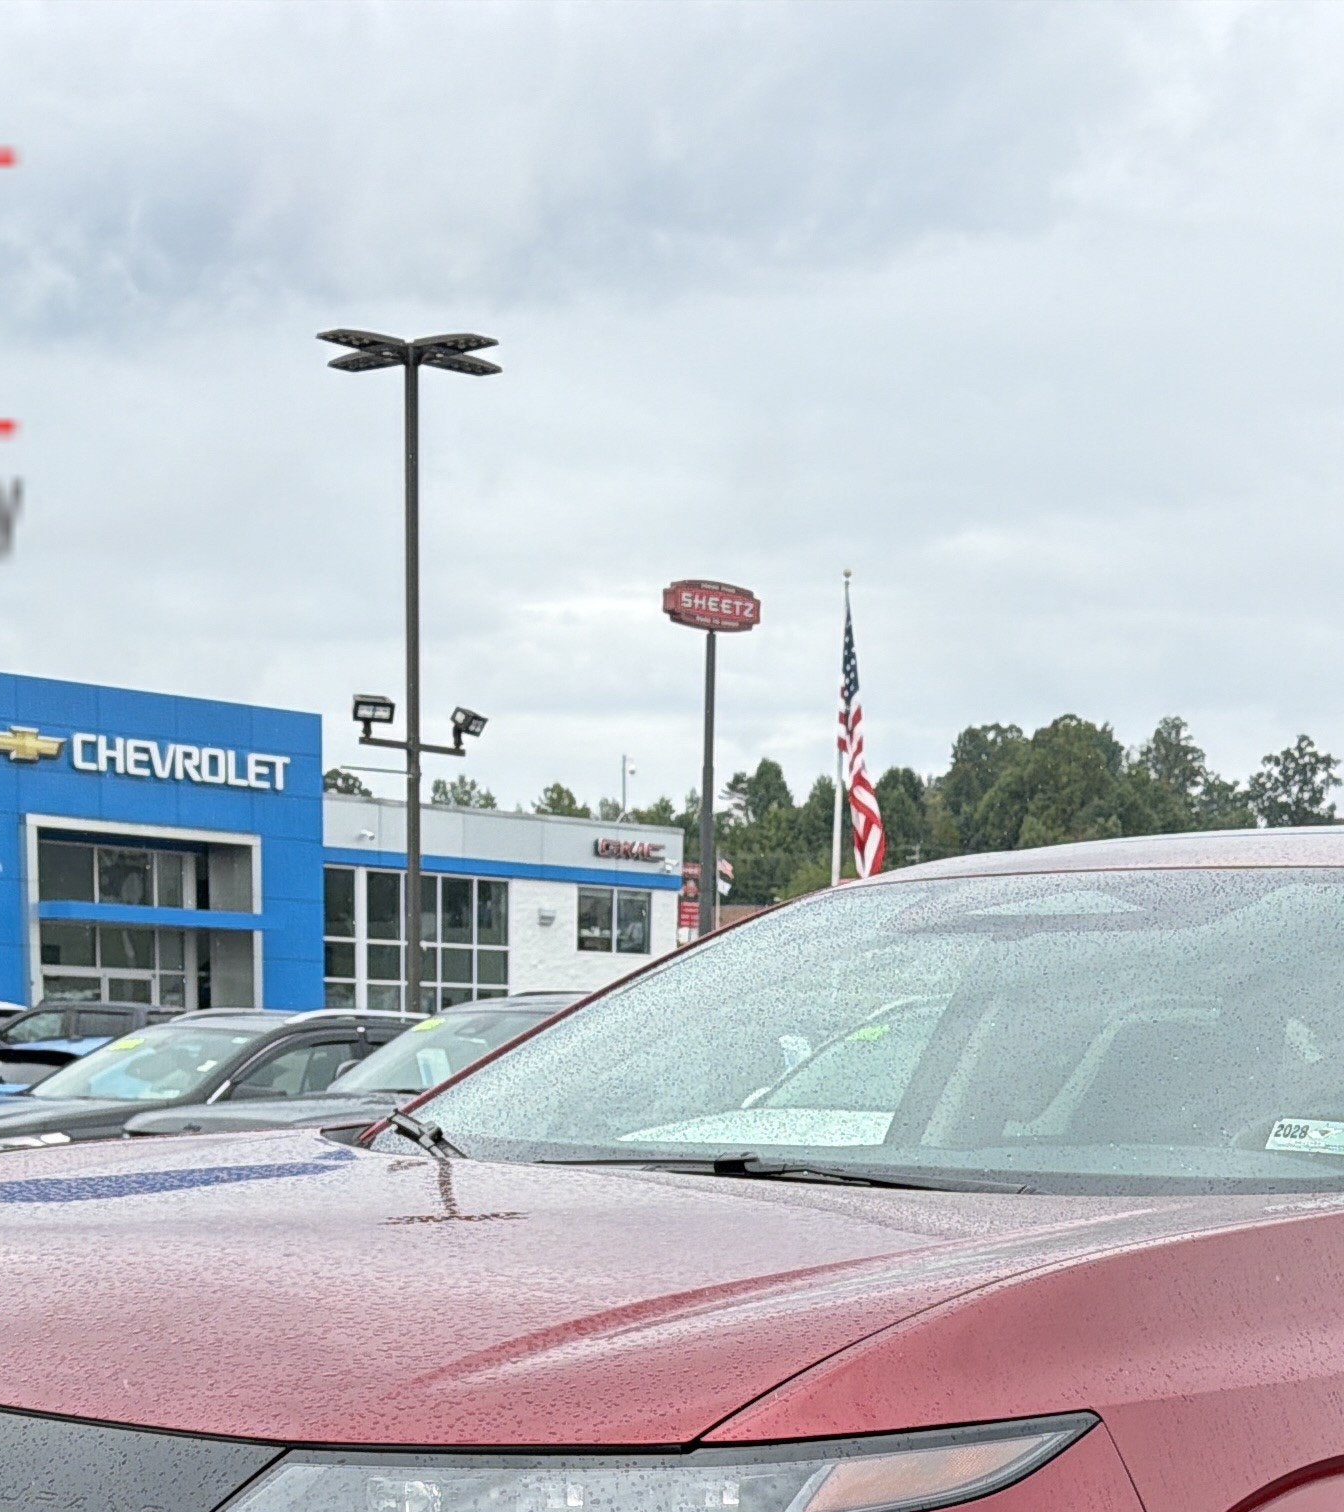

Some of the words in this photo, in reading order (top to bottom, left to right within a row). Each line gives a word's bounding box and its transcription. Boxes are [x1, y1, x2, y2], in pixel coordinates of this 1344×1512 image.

[681, 591, 755, 618] SHEETZ
[72, 732, 292, 791] CHEVROLET
[1274, 1124, 1310, 1139] 2028
